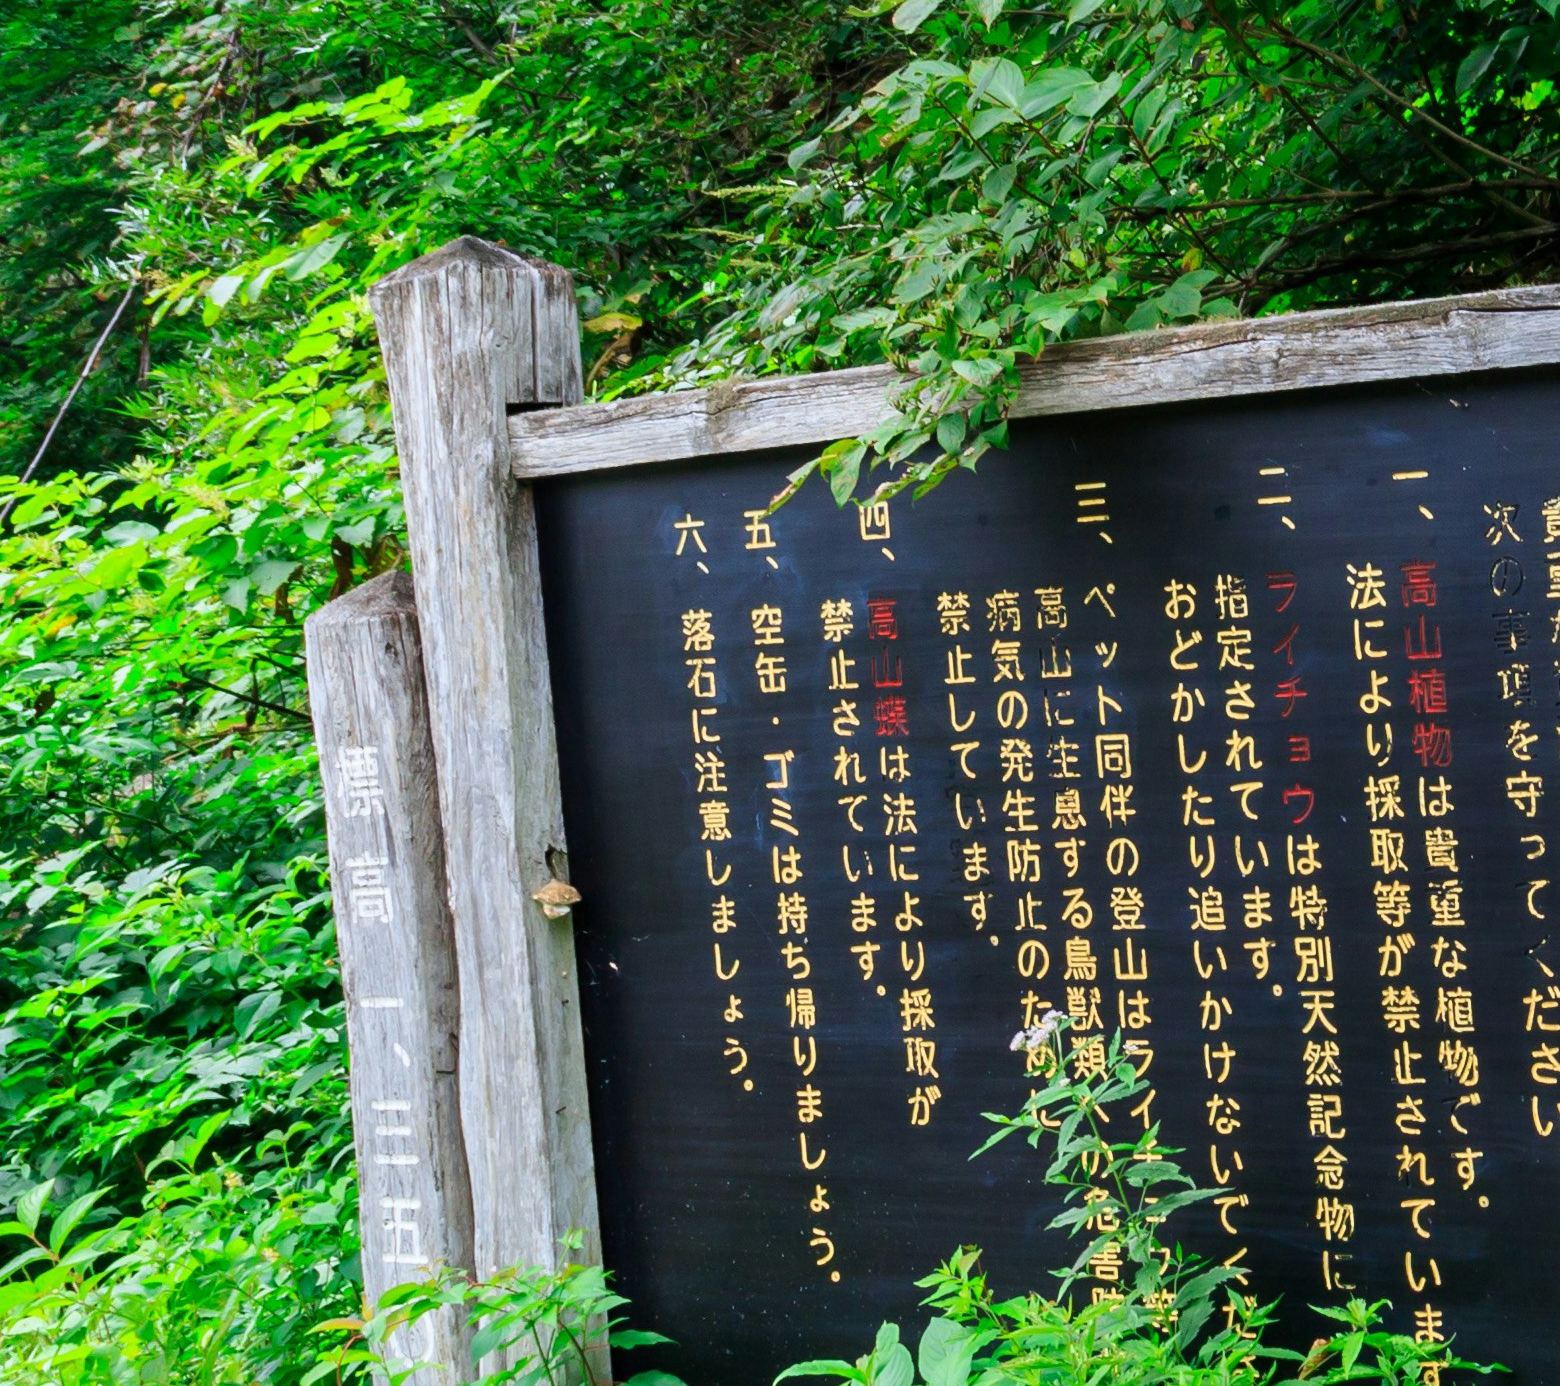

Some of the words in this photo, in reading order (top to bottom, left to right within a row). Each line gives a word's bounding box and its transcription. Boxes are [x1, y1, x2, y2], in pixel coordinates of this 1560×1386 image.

[821, 600, 886, 998] 禁止されています。
[937, 592, 999, 946] 禁止しています。
[1215, 574, 1282, 997] 指定されています。
